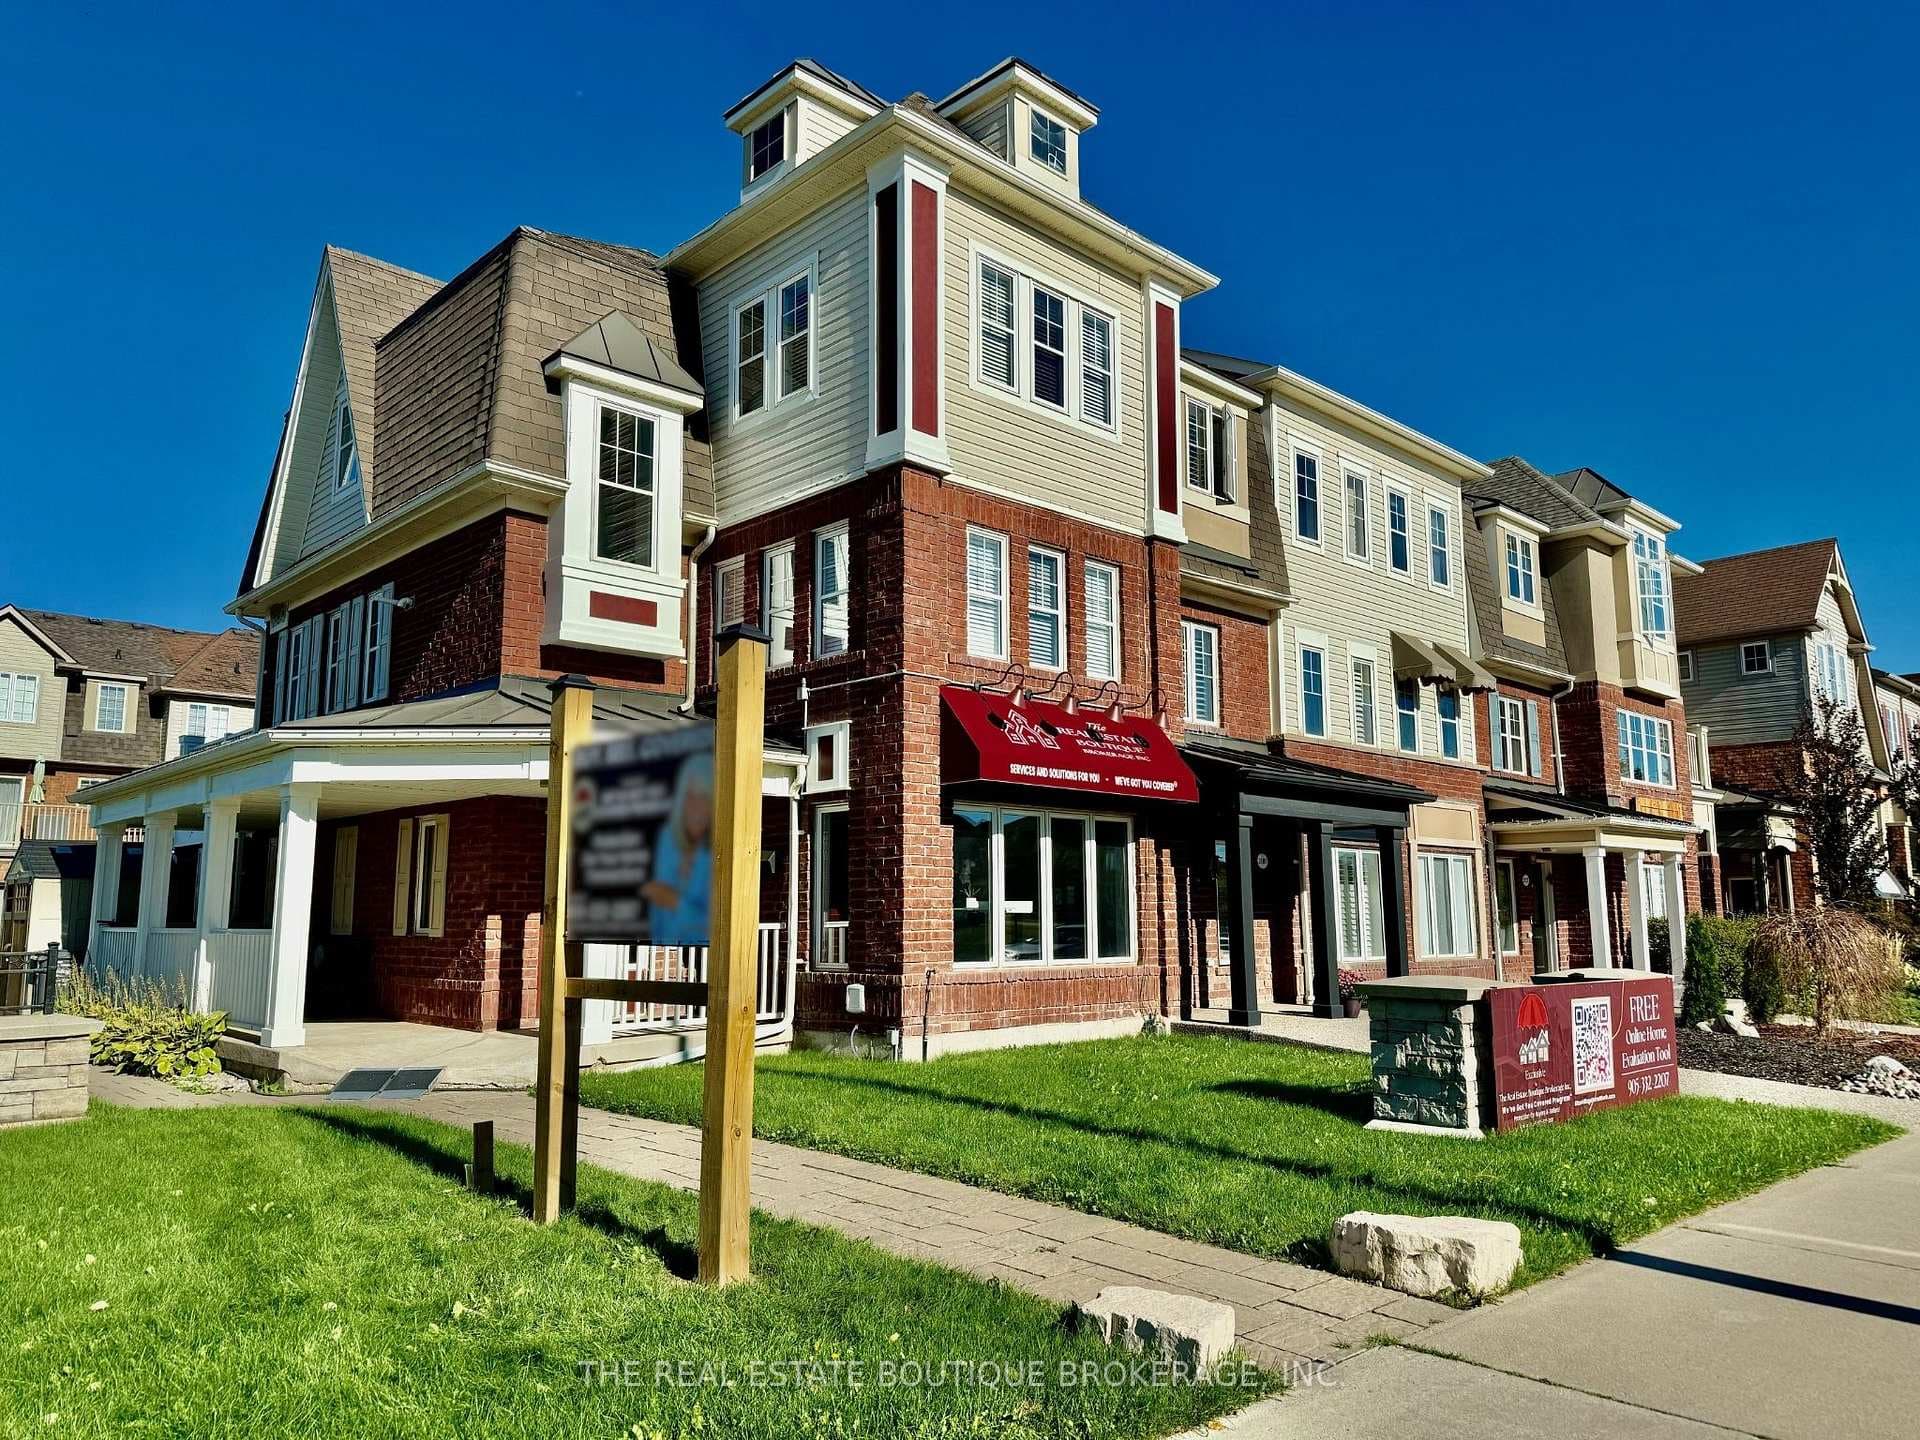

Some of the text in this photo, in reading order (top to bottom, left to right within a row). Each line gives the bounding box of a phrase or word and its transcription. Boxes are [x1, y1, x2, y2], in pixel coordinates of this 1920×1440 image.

[1075, 739, 1145, 754] BOUTIQUE
[1010, 763, 1101, 783] SERVICES AND SOLUTIONS FOR YOU
[1130, 778, 1141, 788] GOT
[1141, 779, 1152, 789] YOU
[1629, 994, 1660, 1023] FREE
[1625, 1025, 1667, 1045] Online Home
[1622, 1043, 1672, 1069] Evaluation Tool
